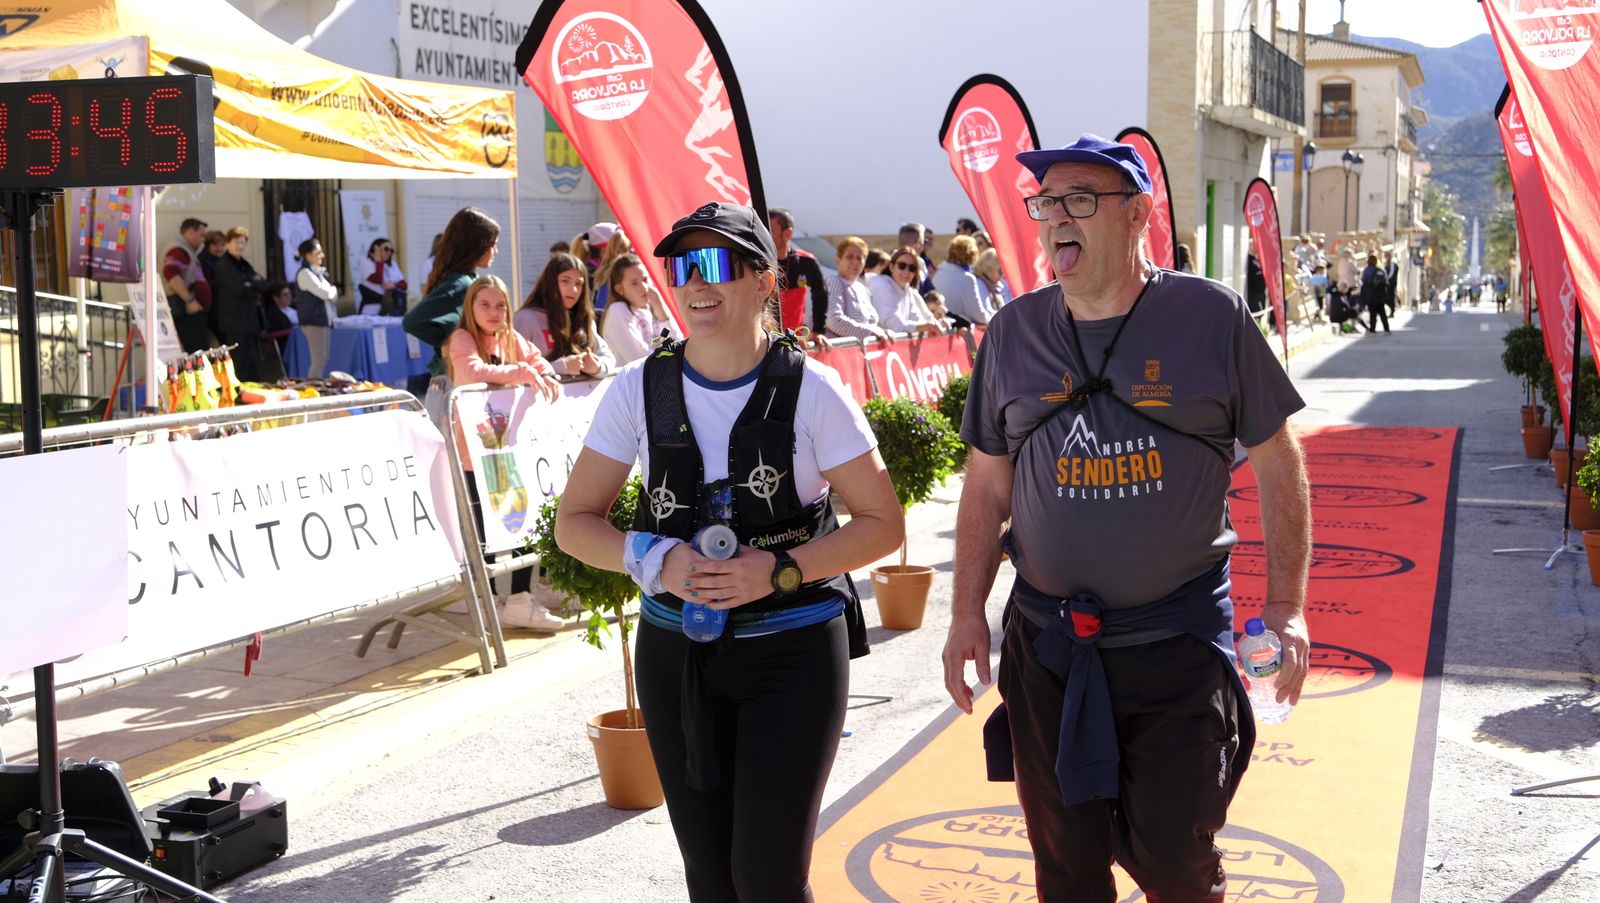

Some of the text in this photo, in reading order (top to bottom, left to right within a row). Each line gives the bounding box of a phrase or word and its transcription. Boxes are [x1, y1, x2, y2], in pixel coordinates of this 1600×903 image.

[414, 48, 530, 87] AYUNTAMIENT
[0, 87, 187, 176] 3:45
[1056, 450, 1163, 486] SENDERO
[128, 455, 417, 530] YUNTAMIENTO DE
[1057, 480, 1163, 500] SOLIDARIO
[748, 526, 808, 548] Columbus
